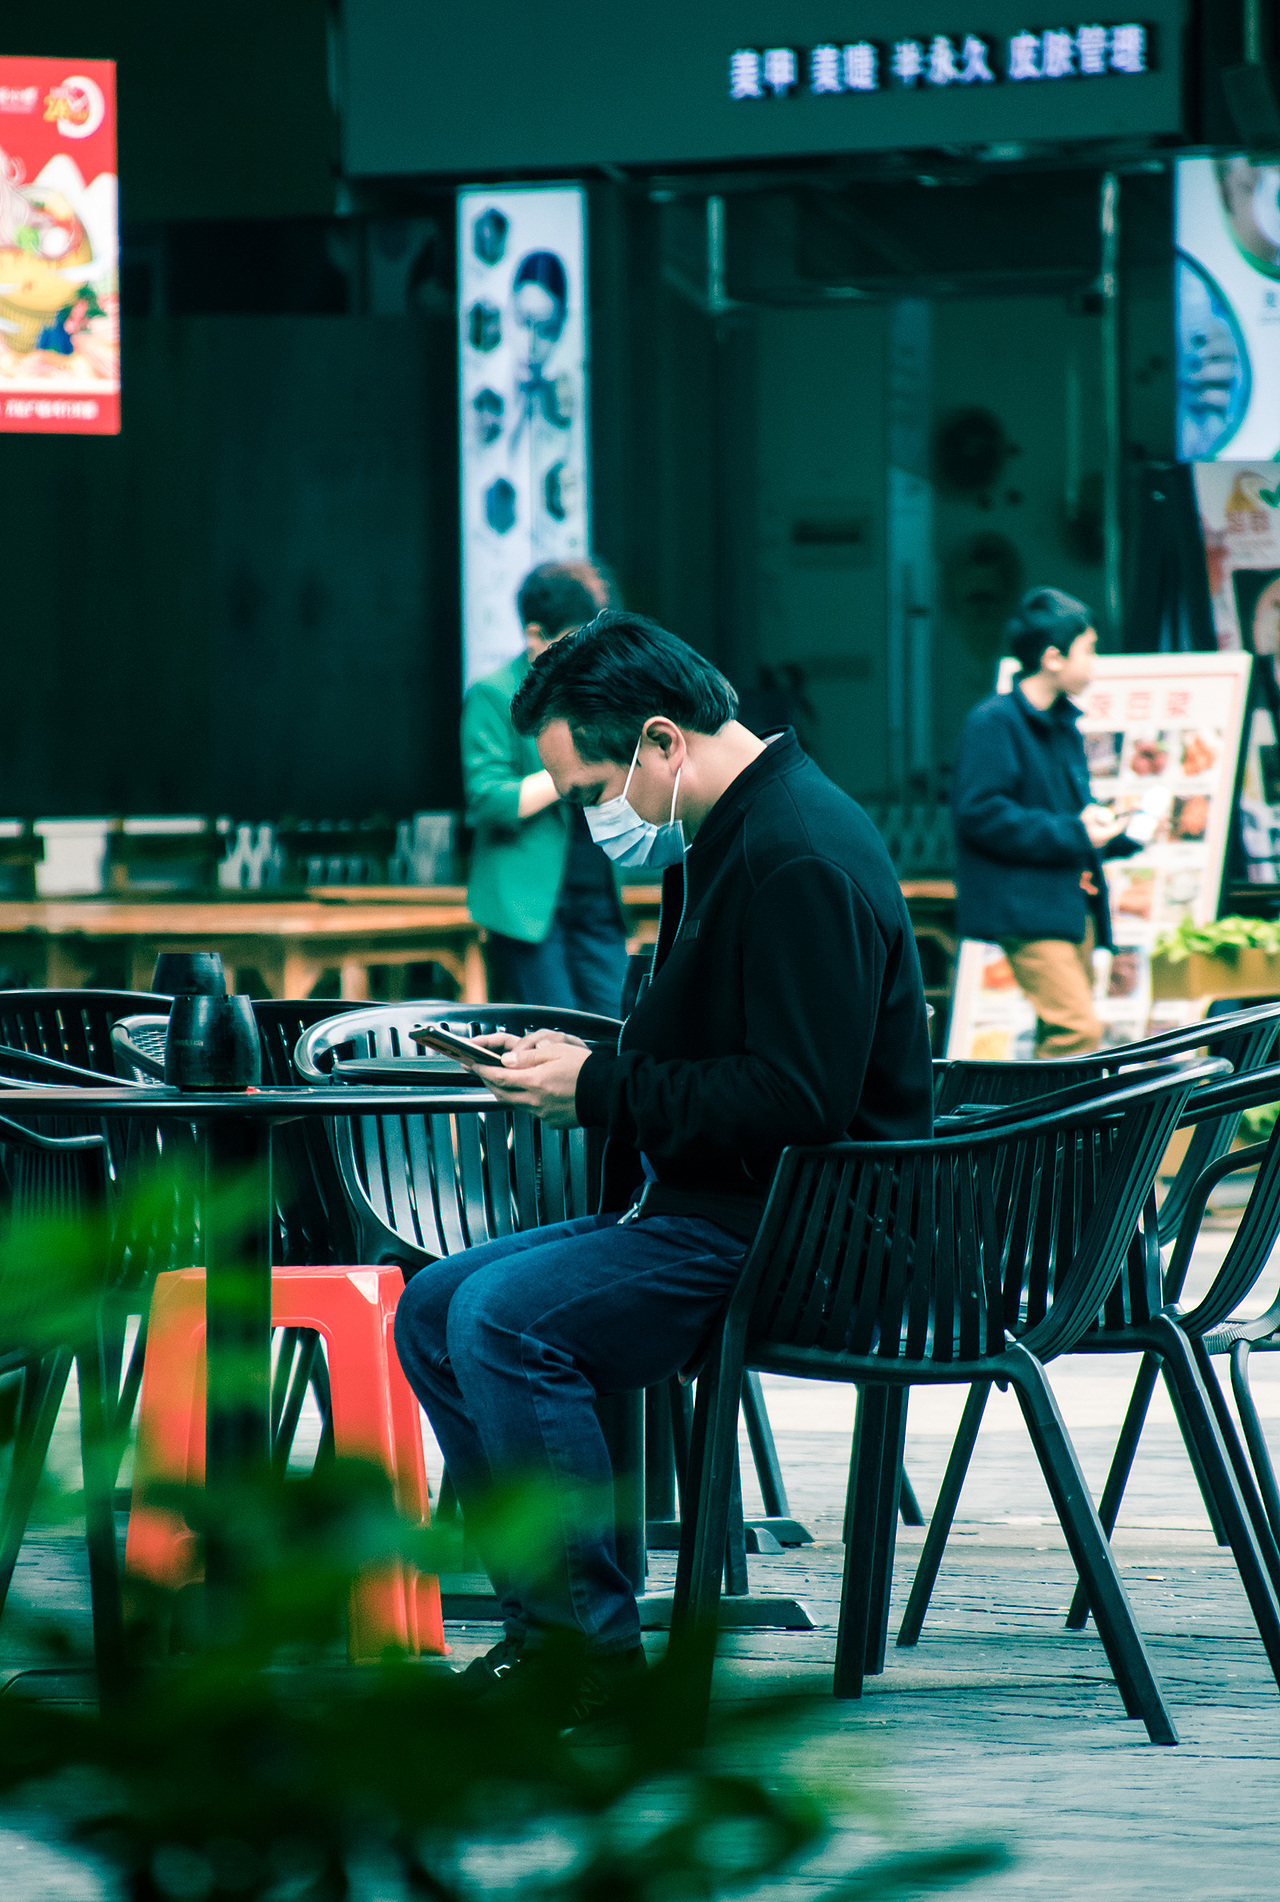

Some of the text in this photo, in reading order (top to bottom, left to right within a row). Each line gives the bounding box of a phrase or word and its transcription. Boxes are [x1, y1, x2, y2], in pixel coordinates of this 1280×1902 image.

[731, 48, 797, 99] 美甲
[892, 36, 993, 86] 半永久
[1009, 24, 1145, 80] 皮肤管理
